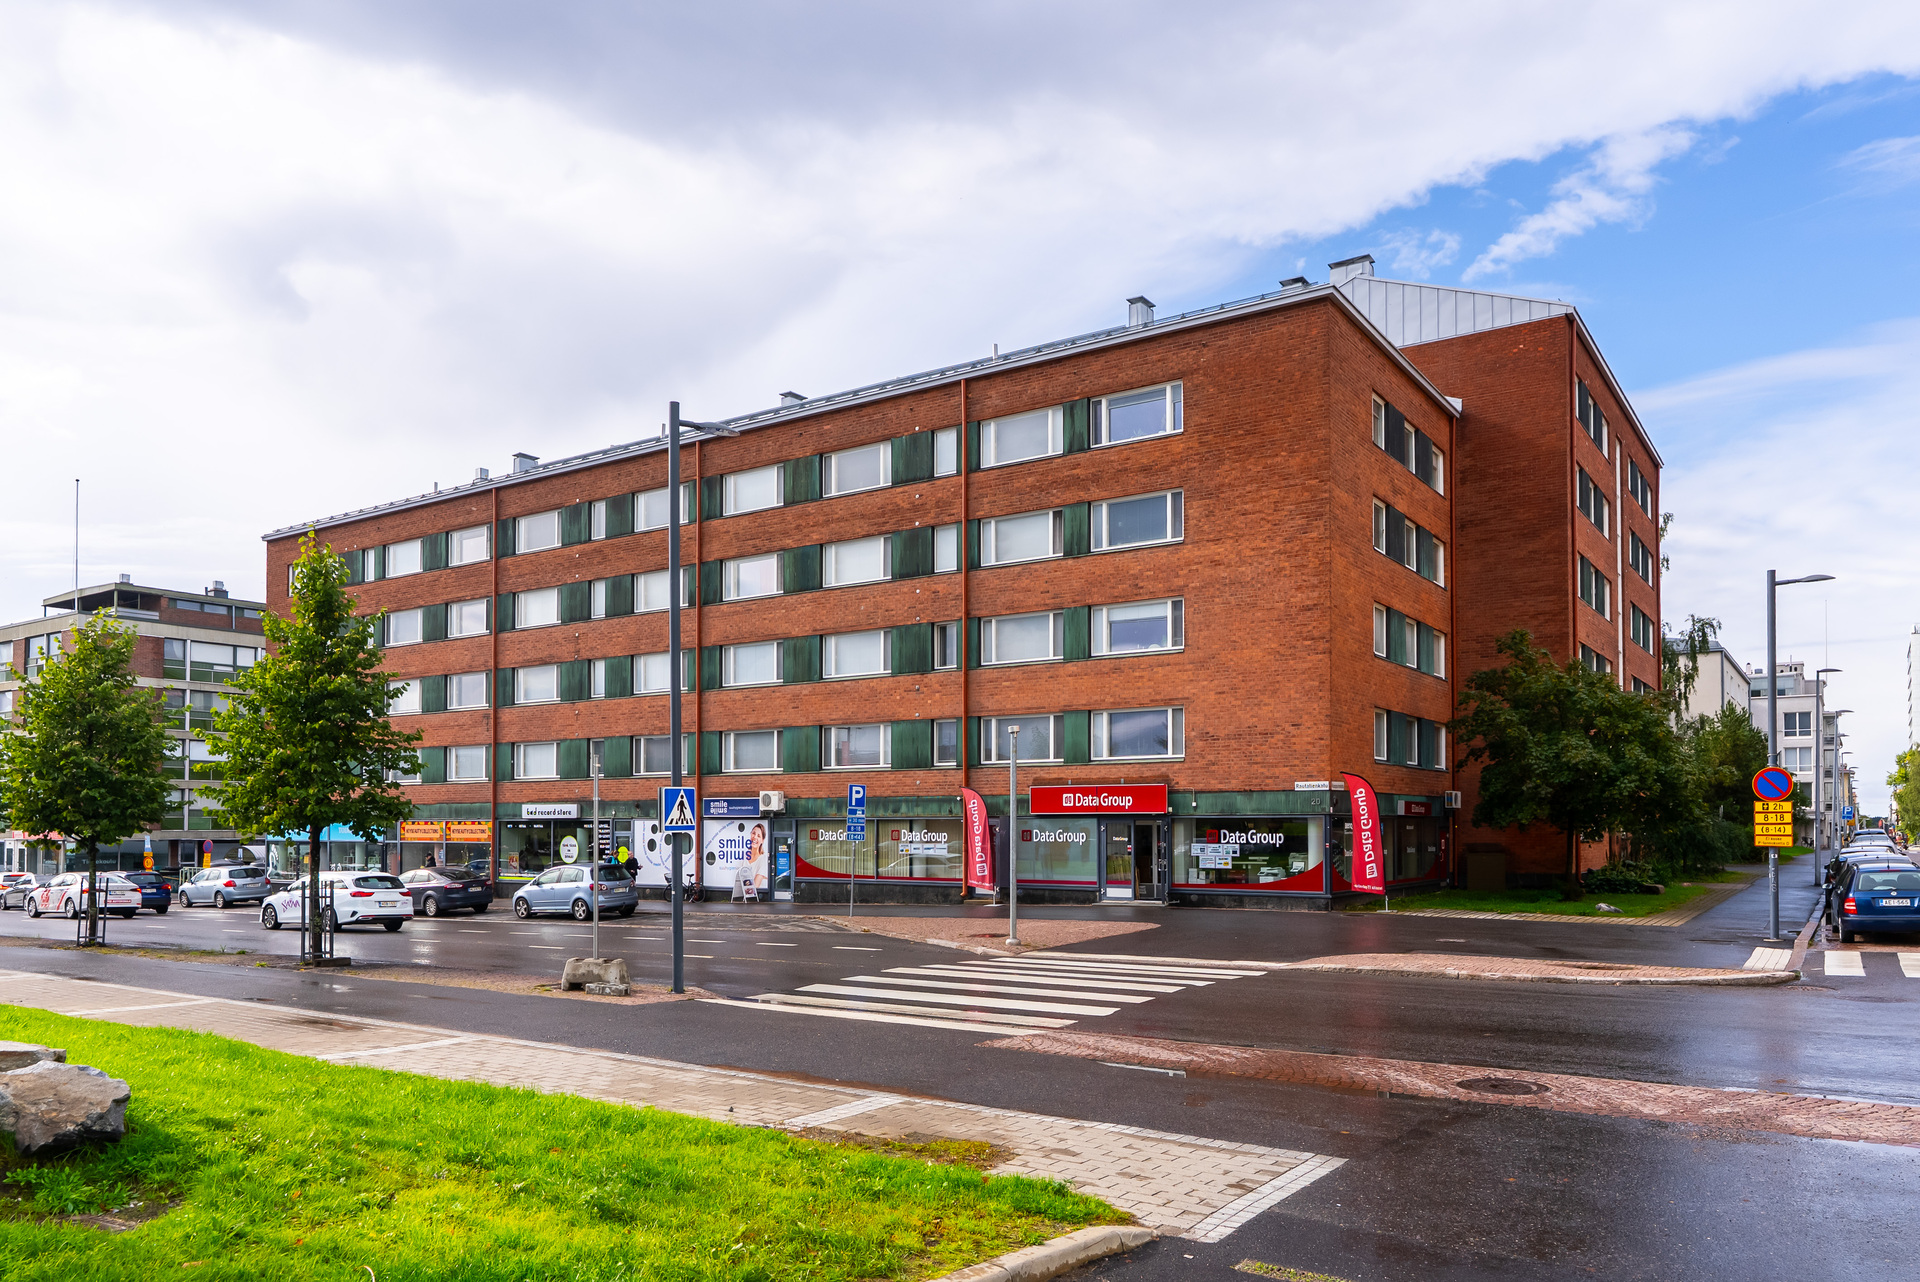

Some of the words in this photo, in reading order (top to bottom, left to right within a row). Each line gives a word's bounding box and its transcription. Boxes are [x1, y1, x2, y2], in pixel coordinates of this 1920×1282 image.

[852, 786, 863, 806] P
[1075, 793, 1099, 807] Data
[1100, 793, 1133, 809] Group
[538, 808, 557, 816] record
[557, 808, 572, 816] store
[718, 835, 752, 849] smile
[819, 829, 837, 841] Data
[901, 829, 921, 841] Data
[921, 829, 948, 844] Group
[1033, 830, 1055, 842] Data
[1056, 829, 1087, 845] Group
[1220, 829, 1247, 844] Data
[1247, 829, 1284, 847] Group
